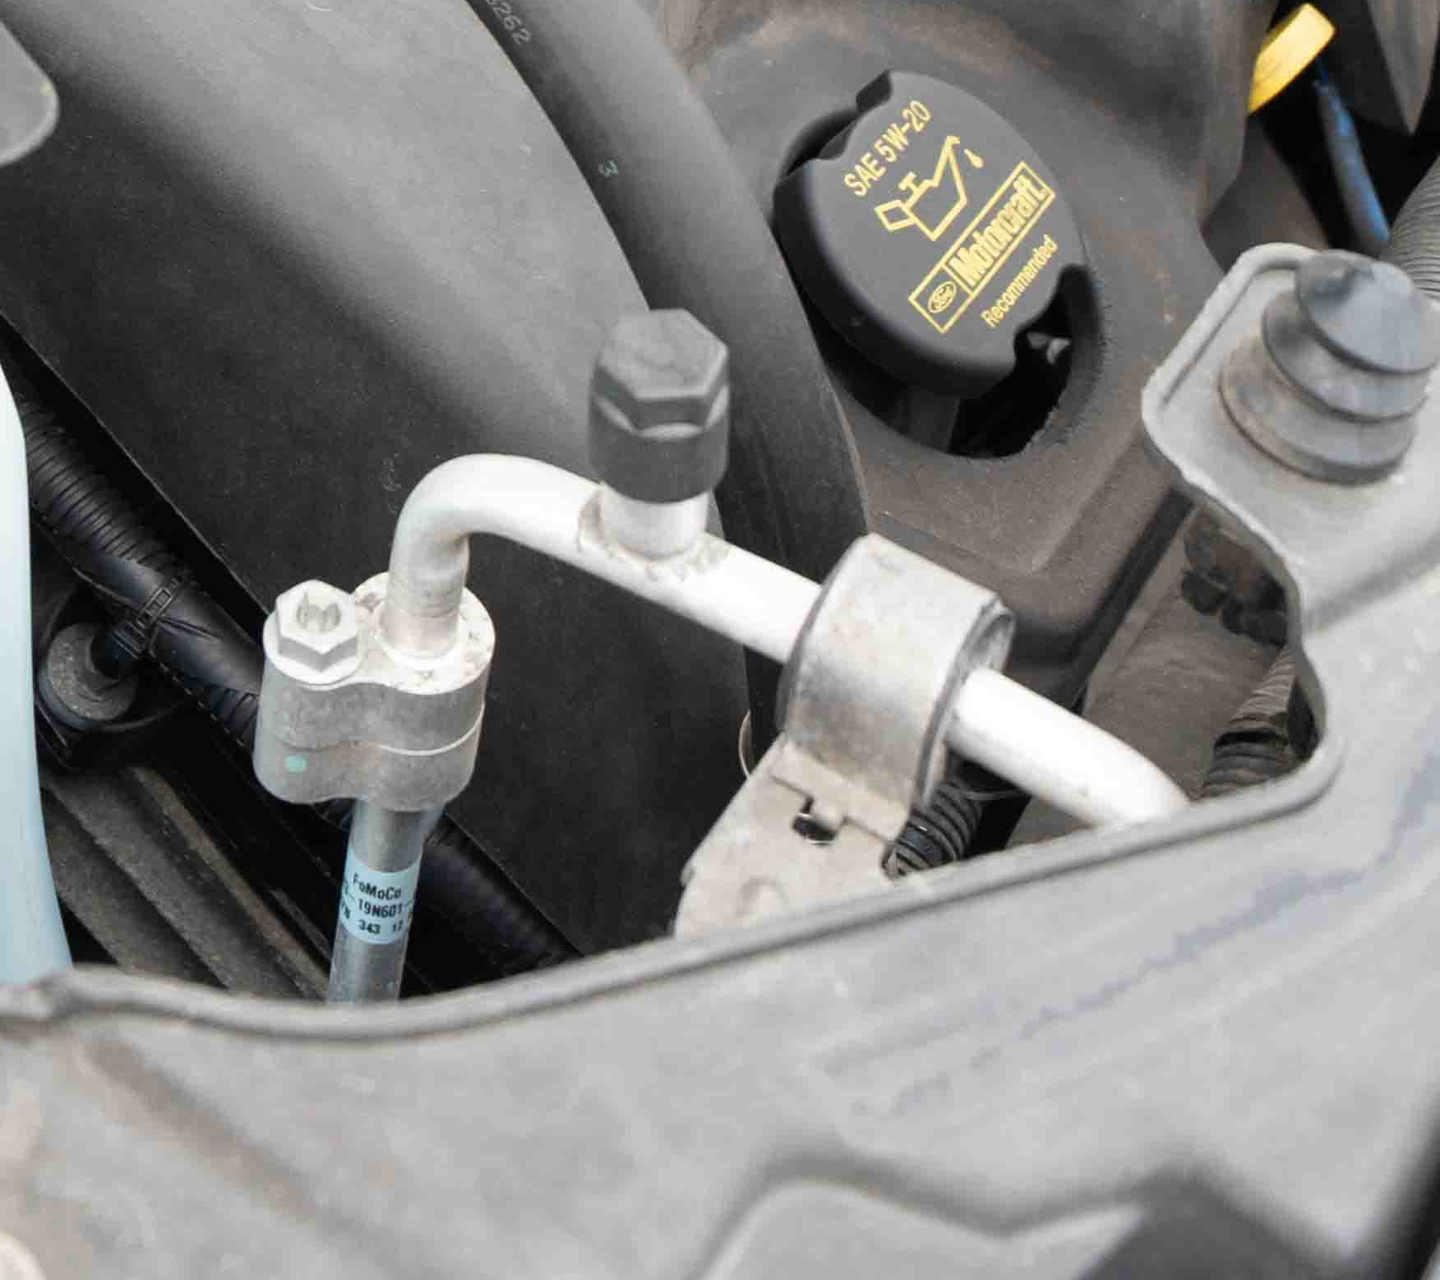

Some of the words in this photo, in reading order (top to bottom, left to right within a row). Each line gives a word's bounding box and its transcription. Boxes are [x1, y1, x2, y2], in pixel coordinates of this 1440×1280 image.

[843, 152, 887, 198] SAE
[873, 99, 932, 163] 5W-20
[948, 173, 1047, 288] Motorcraft
[979, 233, 1060, 329] Recommended
[352, 871, 403, 901] FoMoCo
